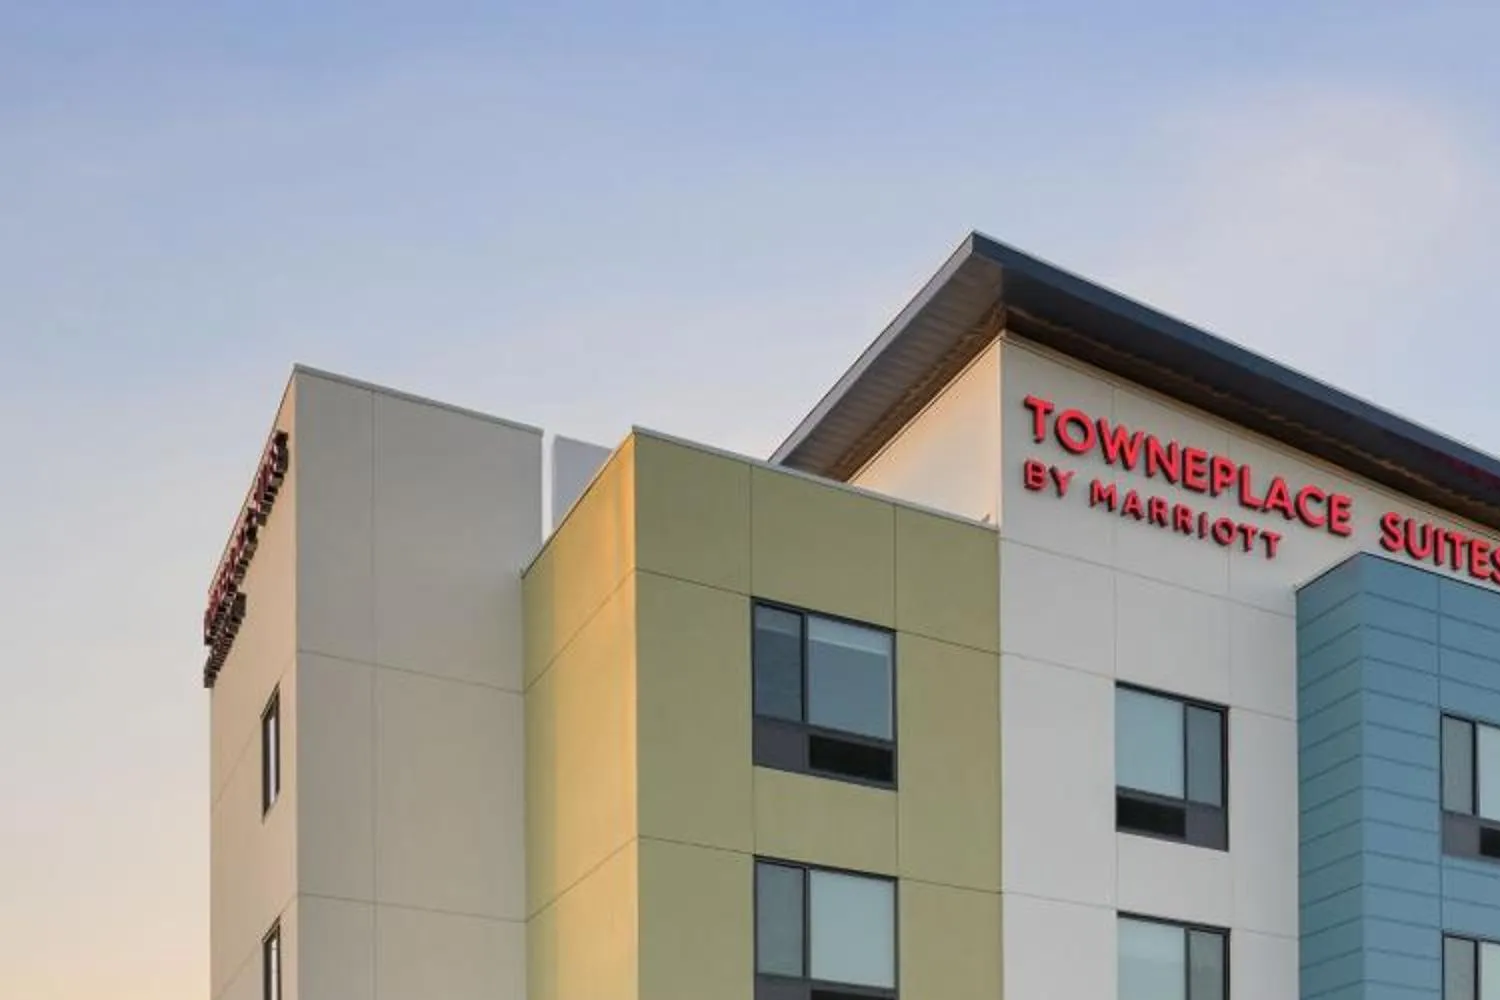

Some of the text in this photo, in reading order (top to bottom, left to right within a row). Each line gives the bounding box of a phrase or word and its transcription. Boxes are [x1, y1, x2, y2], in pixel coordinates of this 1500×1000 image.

[1023, 393, 1354, 536] TOWNEPLACE
[1023, 459, 1282, 560] BY MARRIOTT
